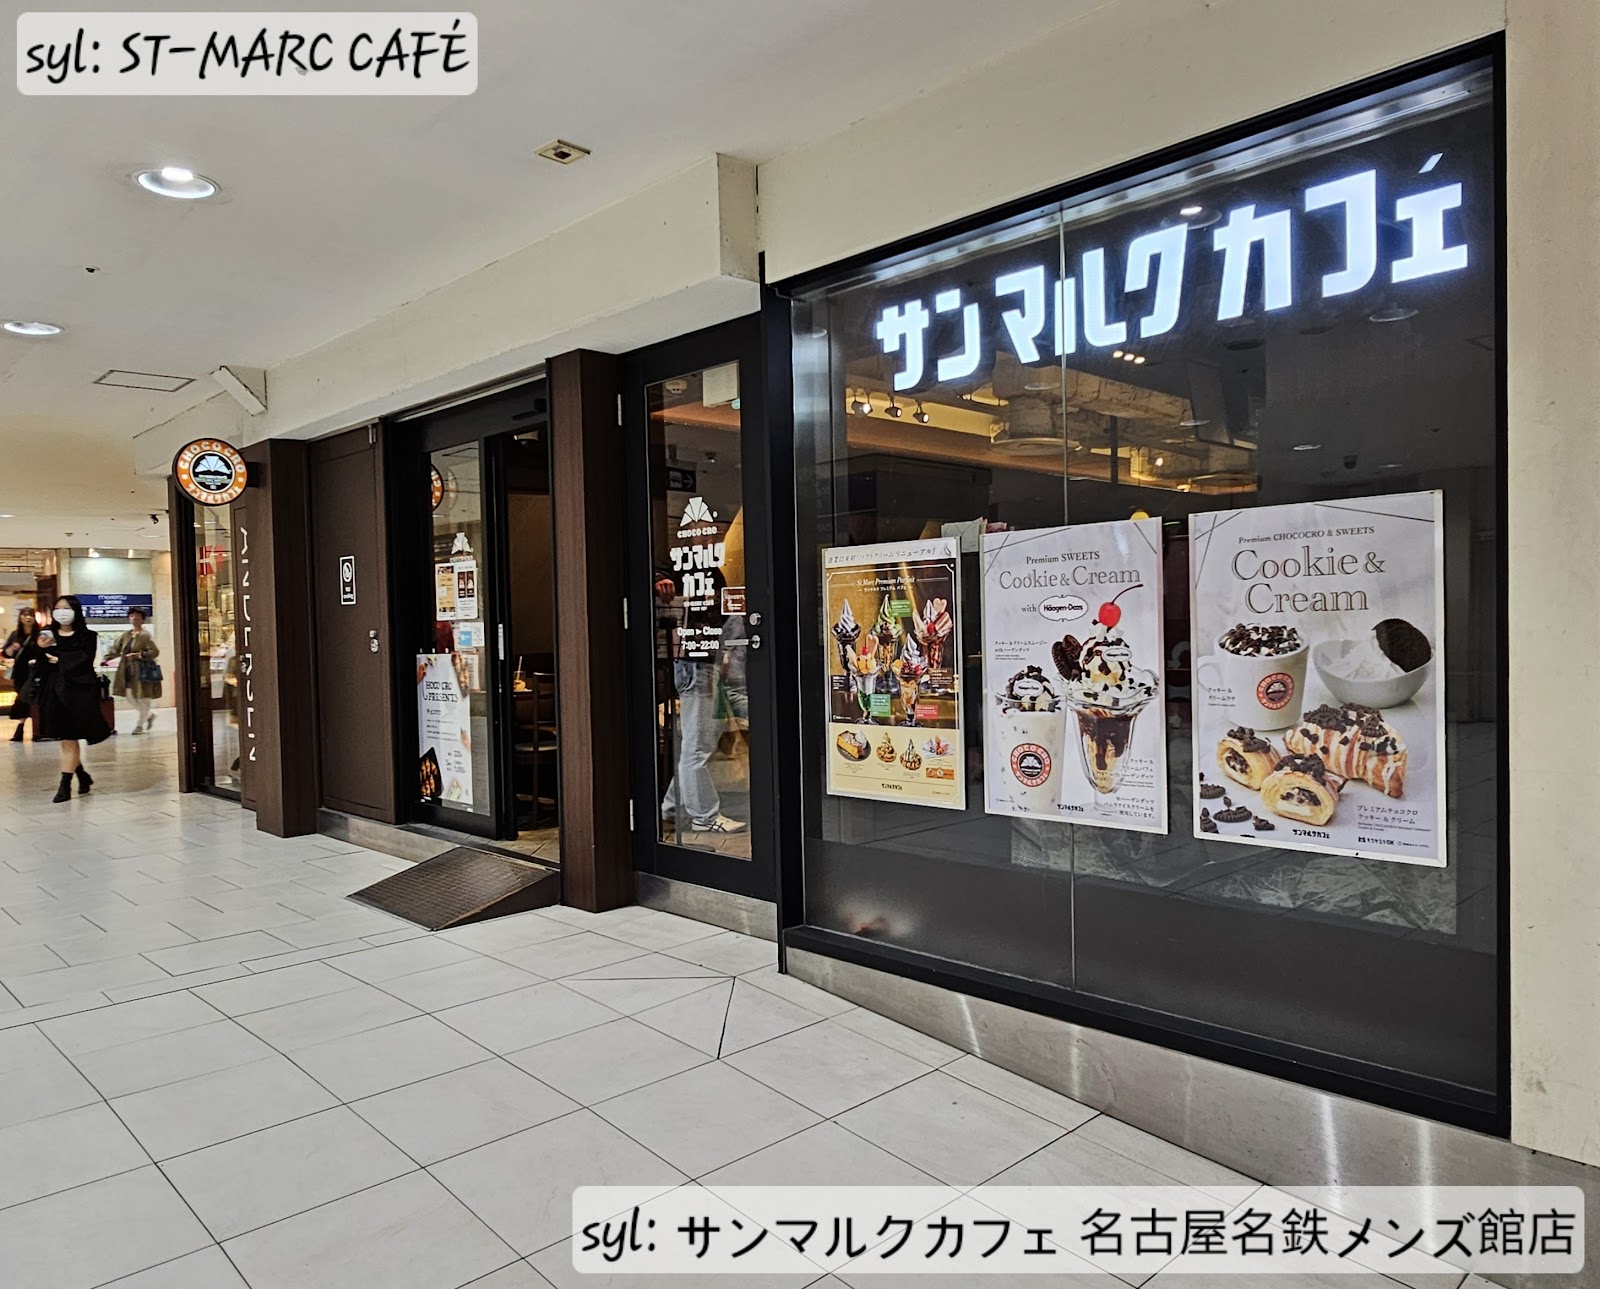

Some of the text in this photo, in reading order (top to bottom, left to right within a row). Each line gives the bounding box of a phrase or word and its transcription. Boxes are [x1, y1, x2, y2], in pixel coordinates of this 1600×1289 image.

[677, 526, 717, 539] CHOCO CRO
[1239, 526, 1375, 544] Premium CHOCOCRO & SWEETS
[669, 542, 726, 572] サンマルク
[1026, 551, 1100, 565] Premium SWEETS
[1231, 545, 1386, 581] Cookie &
[1000, 566, 1141, 589] Cookie & Cream
[1245, 582, 1370, 614] Cream
[1021, 605, 1037, 613] with
[677, 627, 695, 638] Open
[1357, 805, 1418, 815] プレミアムチョコクロ
